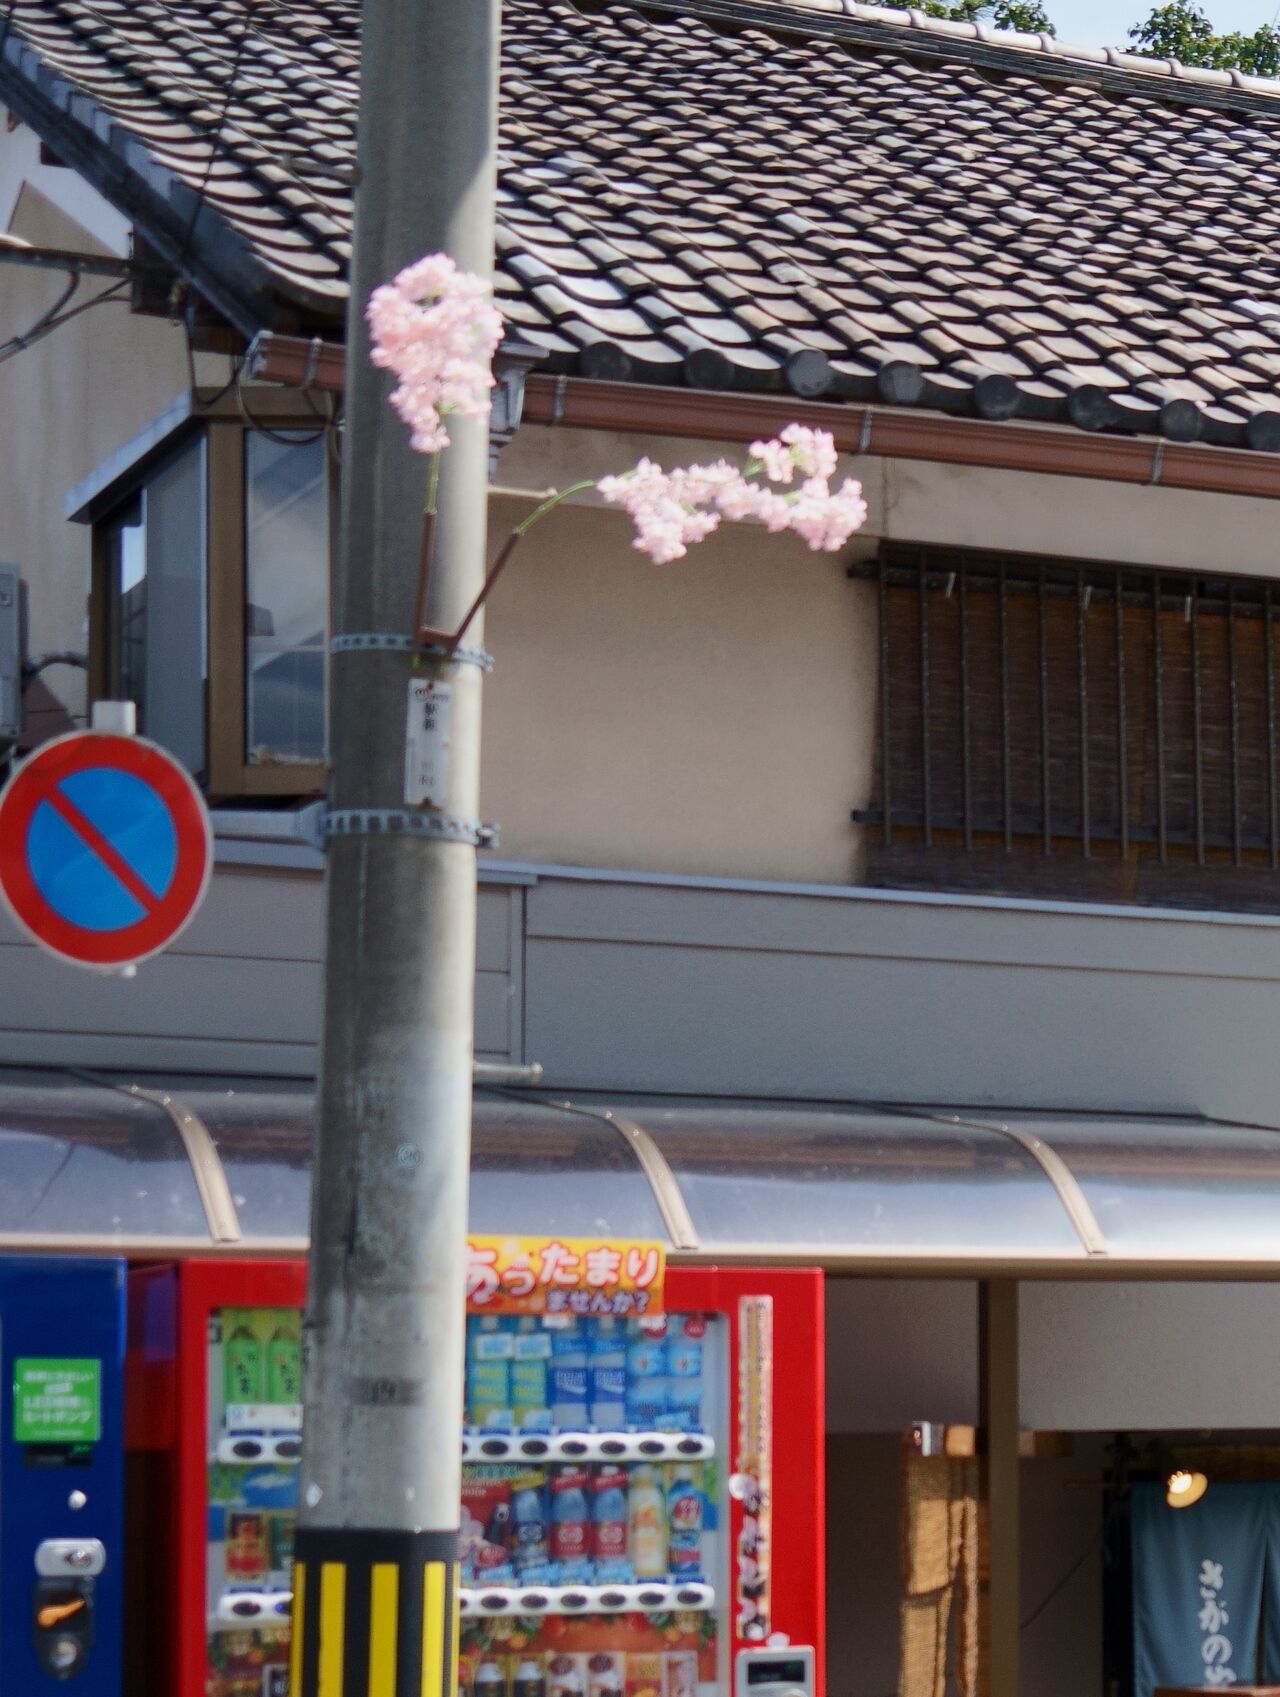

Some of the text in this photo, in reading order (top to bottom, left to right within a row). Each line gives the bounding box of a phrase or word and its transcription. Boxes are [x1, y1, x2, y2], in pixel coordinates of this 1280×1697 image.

[467, 1242, 659, 1304] あったまり
[547, 1288, 650, 1314] ませんか?
